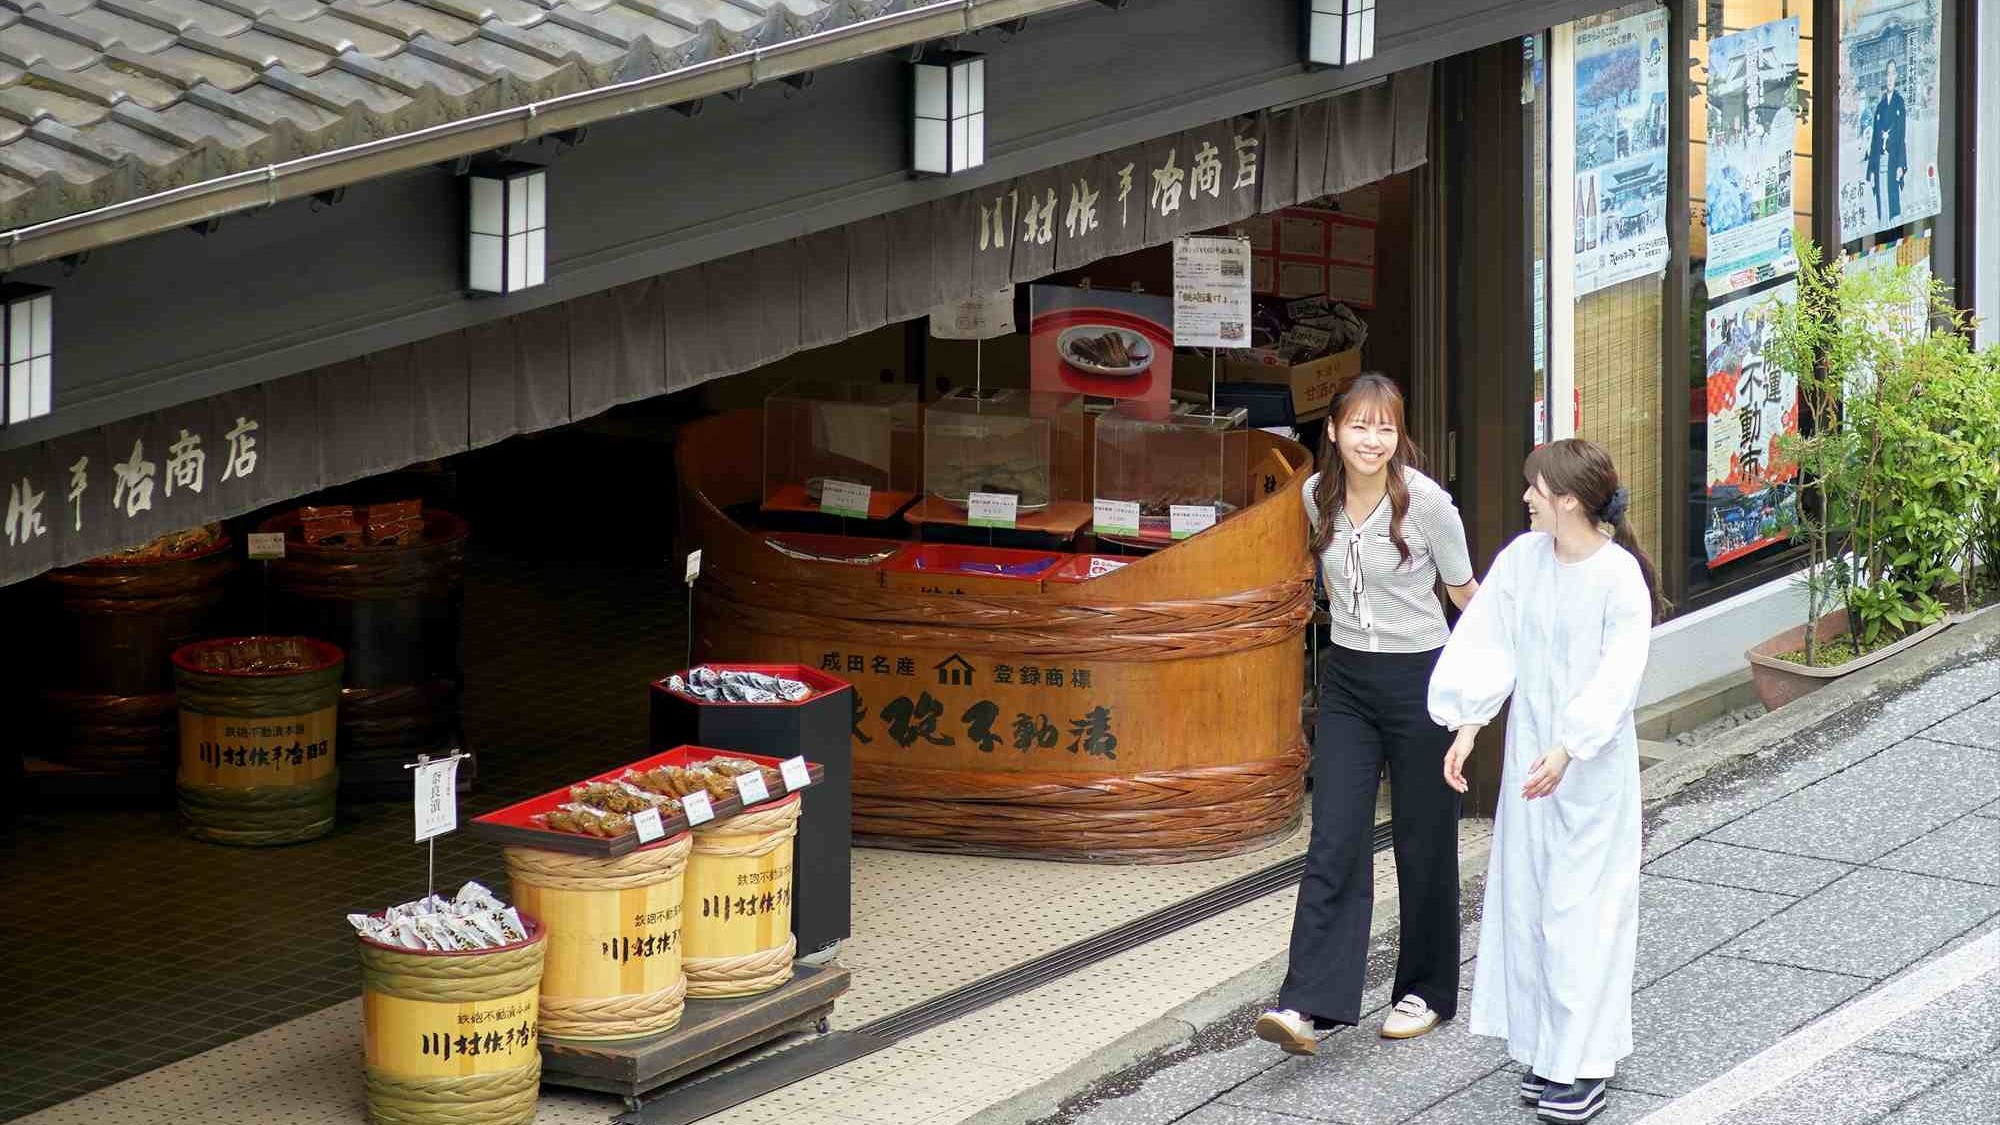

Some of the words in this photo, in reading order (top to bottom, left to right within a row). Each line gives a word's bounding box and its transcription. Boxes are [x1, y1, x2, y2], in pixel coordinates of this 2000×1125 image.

[1739, 361, 1763, 482] 不動市
[821, 651, 917, 677] 成田名産
[993, 664, 1093, 689] 登録商標
